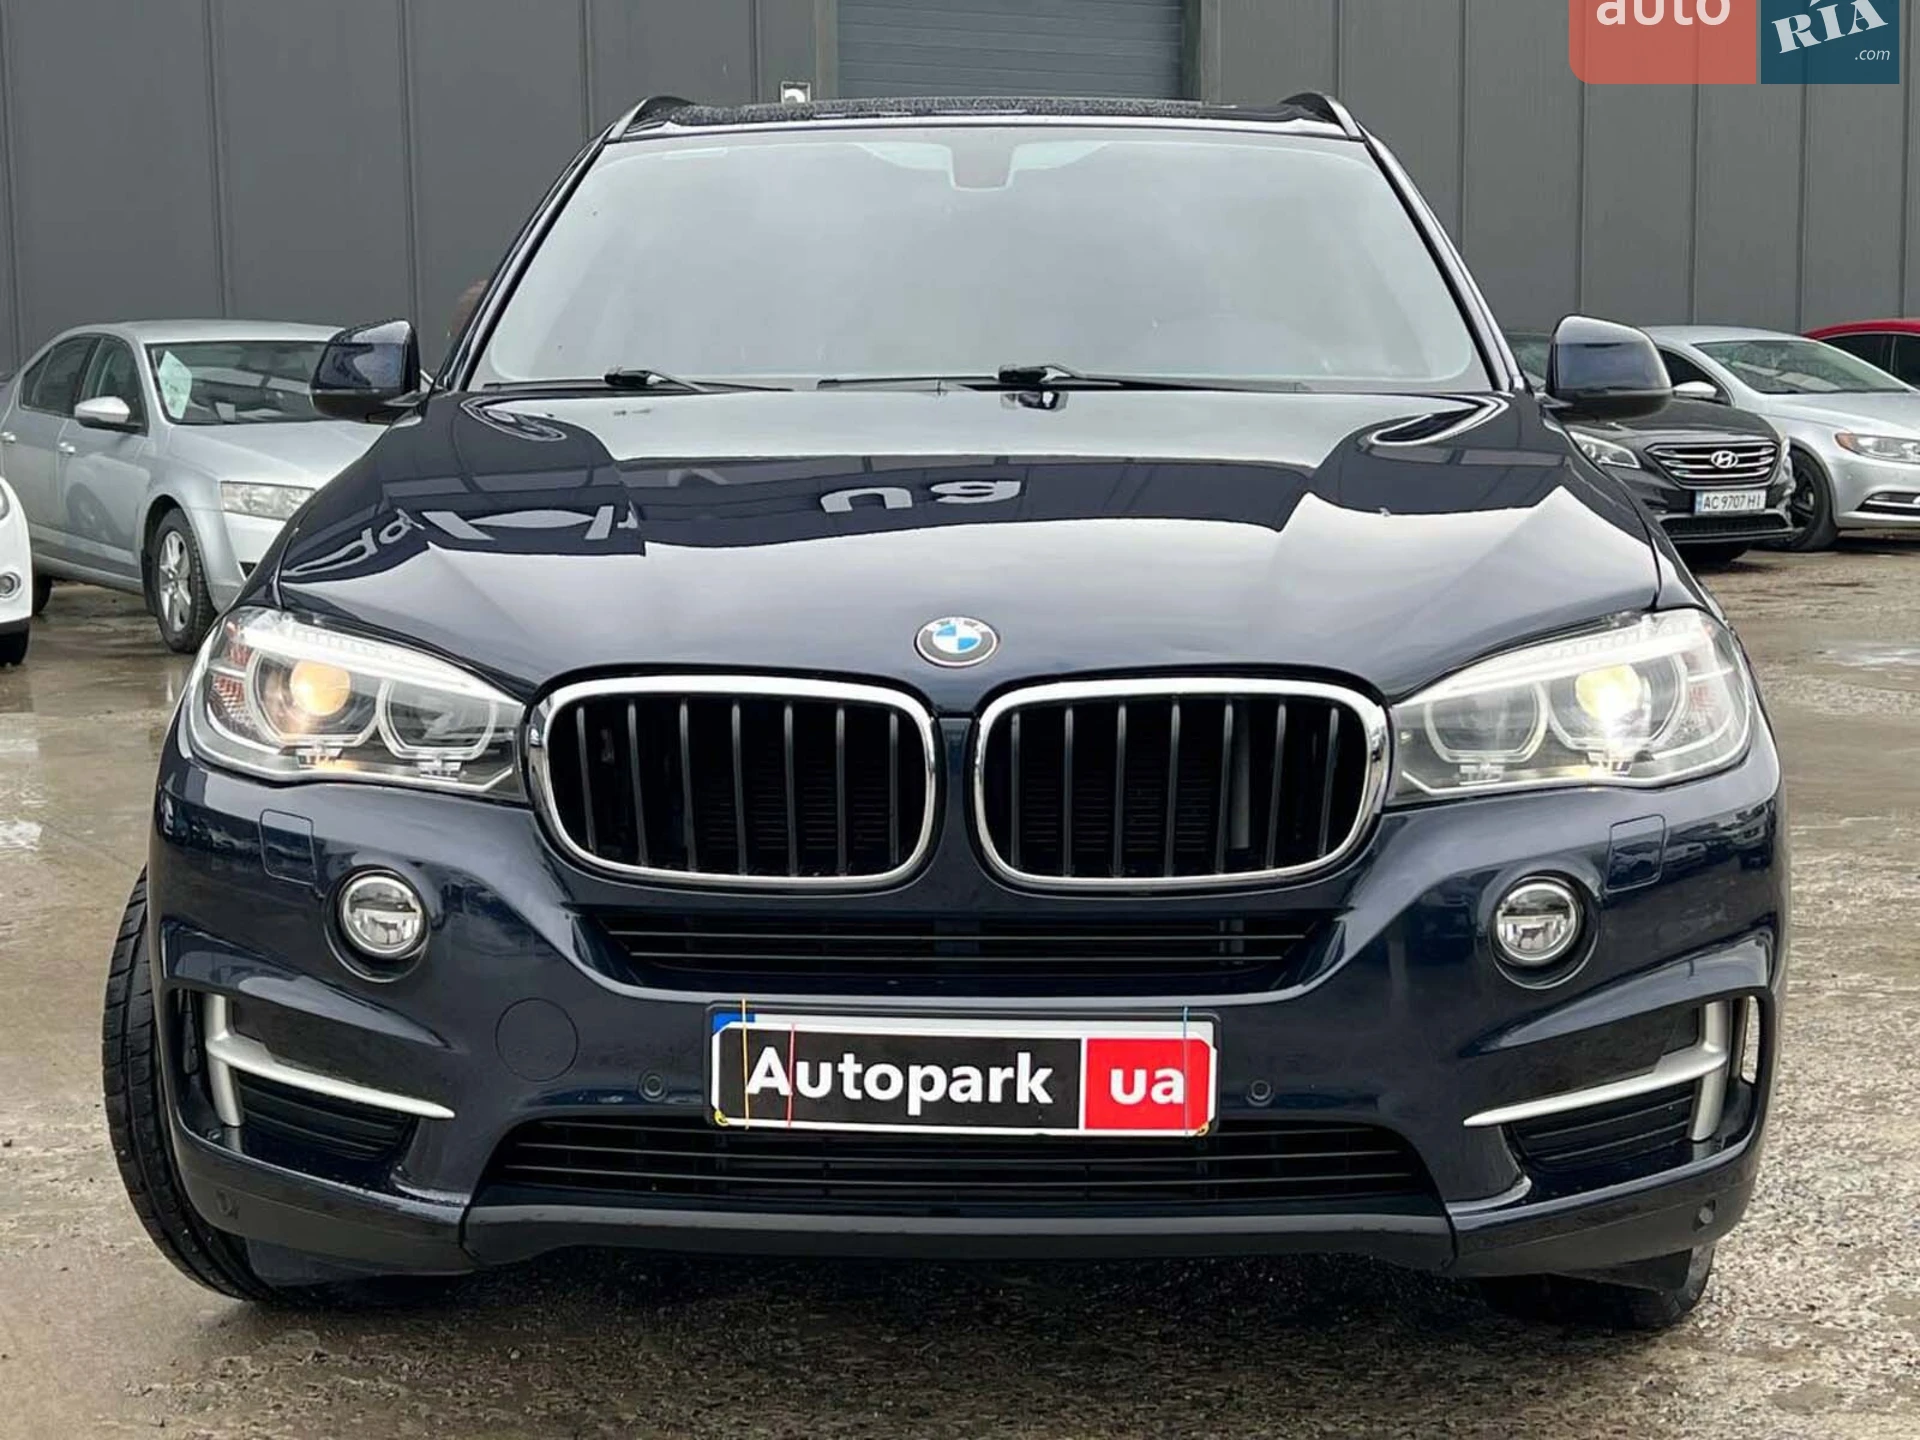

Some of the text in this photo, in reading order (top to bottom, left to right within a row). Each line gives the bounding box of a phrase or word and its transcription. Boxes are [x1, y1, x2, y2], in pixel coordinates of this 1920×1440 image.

[1703, 493, 1761, 510] AC 9707 HI
[745, 1046, 1186, 1116] Autopark ua
